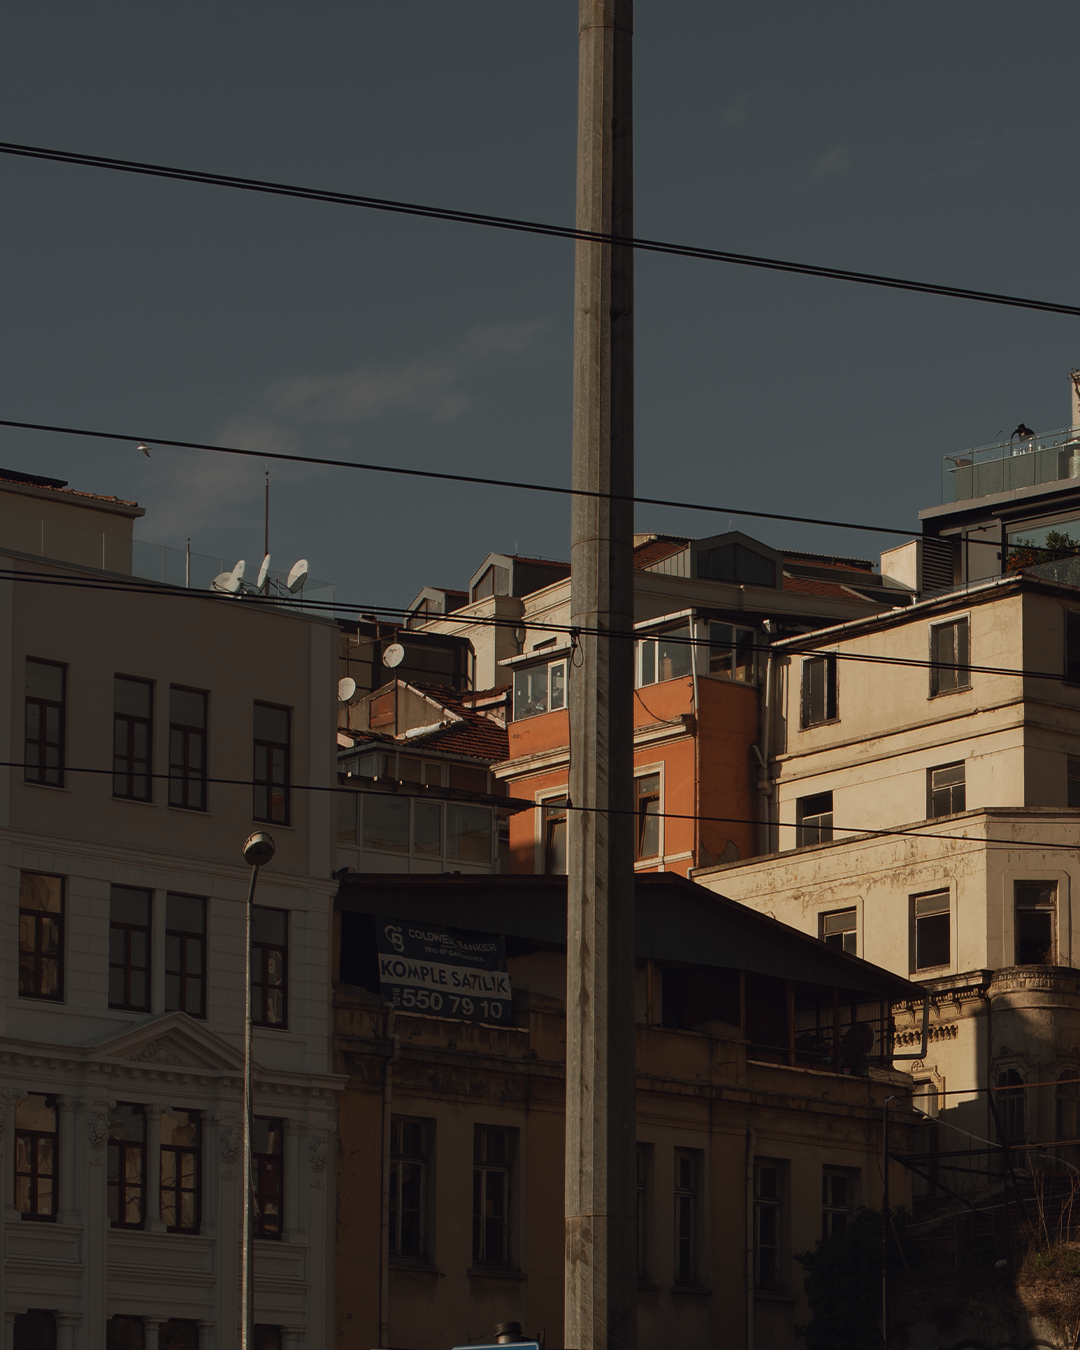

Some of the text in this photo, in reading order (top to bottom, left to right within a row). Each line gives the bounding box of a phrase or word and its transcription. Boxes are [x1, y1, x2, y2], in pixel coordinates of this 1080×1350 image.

[457, 940, 497, 952] BANKER
[381, 960, 508, 993] KOMPLE SATILIK
[392, 987, 401, 1007] 0216
[402, 988, 503, 1019] 550 79 10
